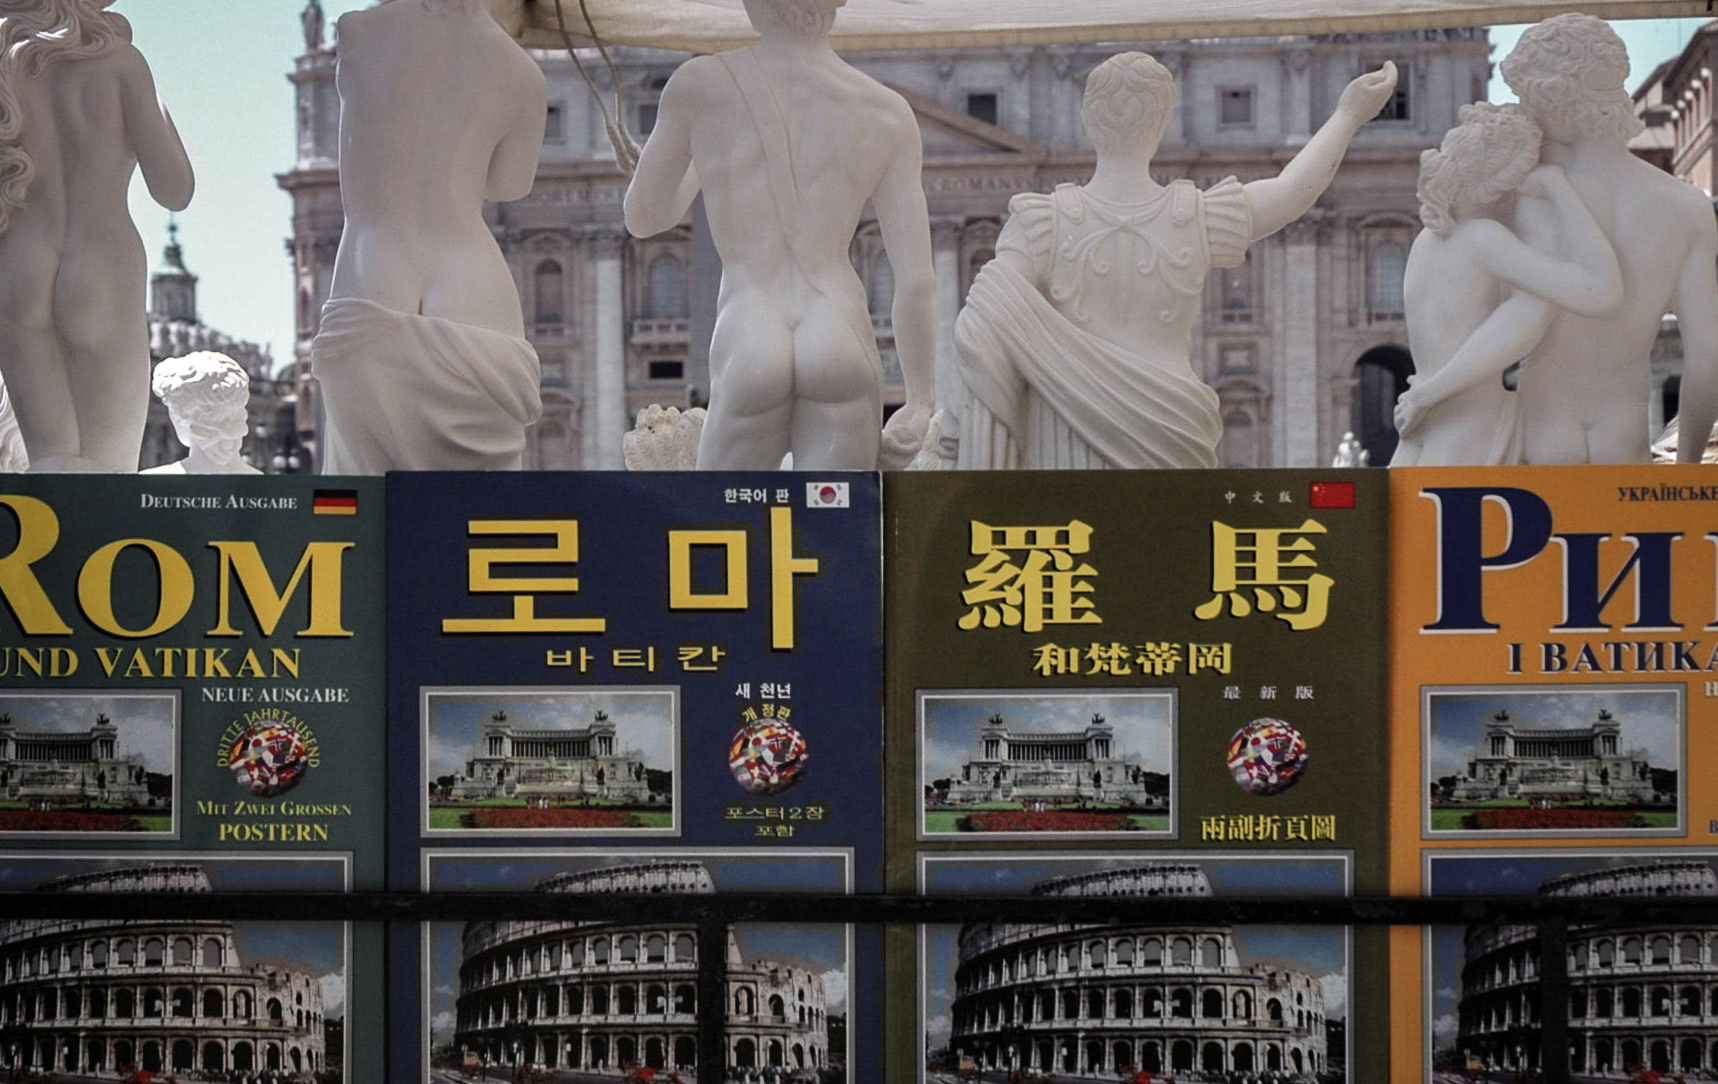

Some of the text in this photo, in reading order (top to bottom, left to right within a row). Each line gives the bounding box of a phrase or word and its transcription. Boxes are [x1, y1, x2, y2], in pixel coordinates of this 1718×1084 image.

[725, 489, 789, 503] 한국어 판
[959, 519, 1334, 632] 羅馬
[94, 647, 301, 678] VATIKAN
[547, 646, 725, 672] 바티칸
[1034, 642, 1231, 676] 和梵蒂岡
[203, 688, 348, 702] NEUE AUSGABE
[736, 683, 790, 698] 새 천년
[1224, 686, 1313, 699] 最新版
[216, 707, 321, 768] DRITTE JAHRTAUSEND
[221, 824, 327, 840] POSTERN
[1202, 815, 1335, 840] 兩副折頁圖
